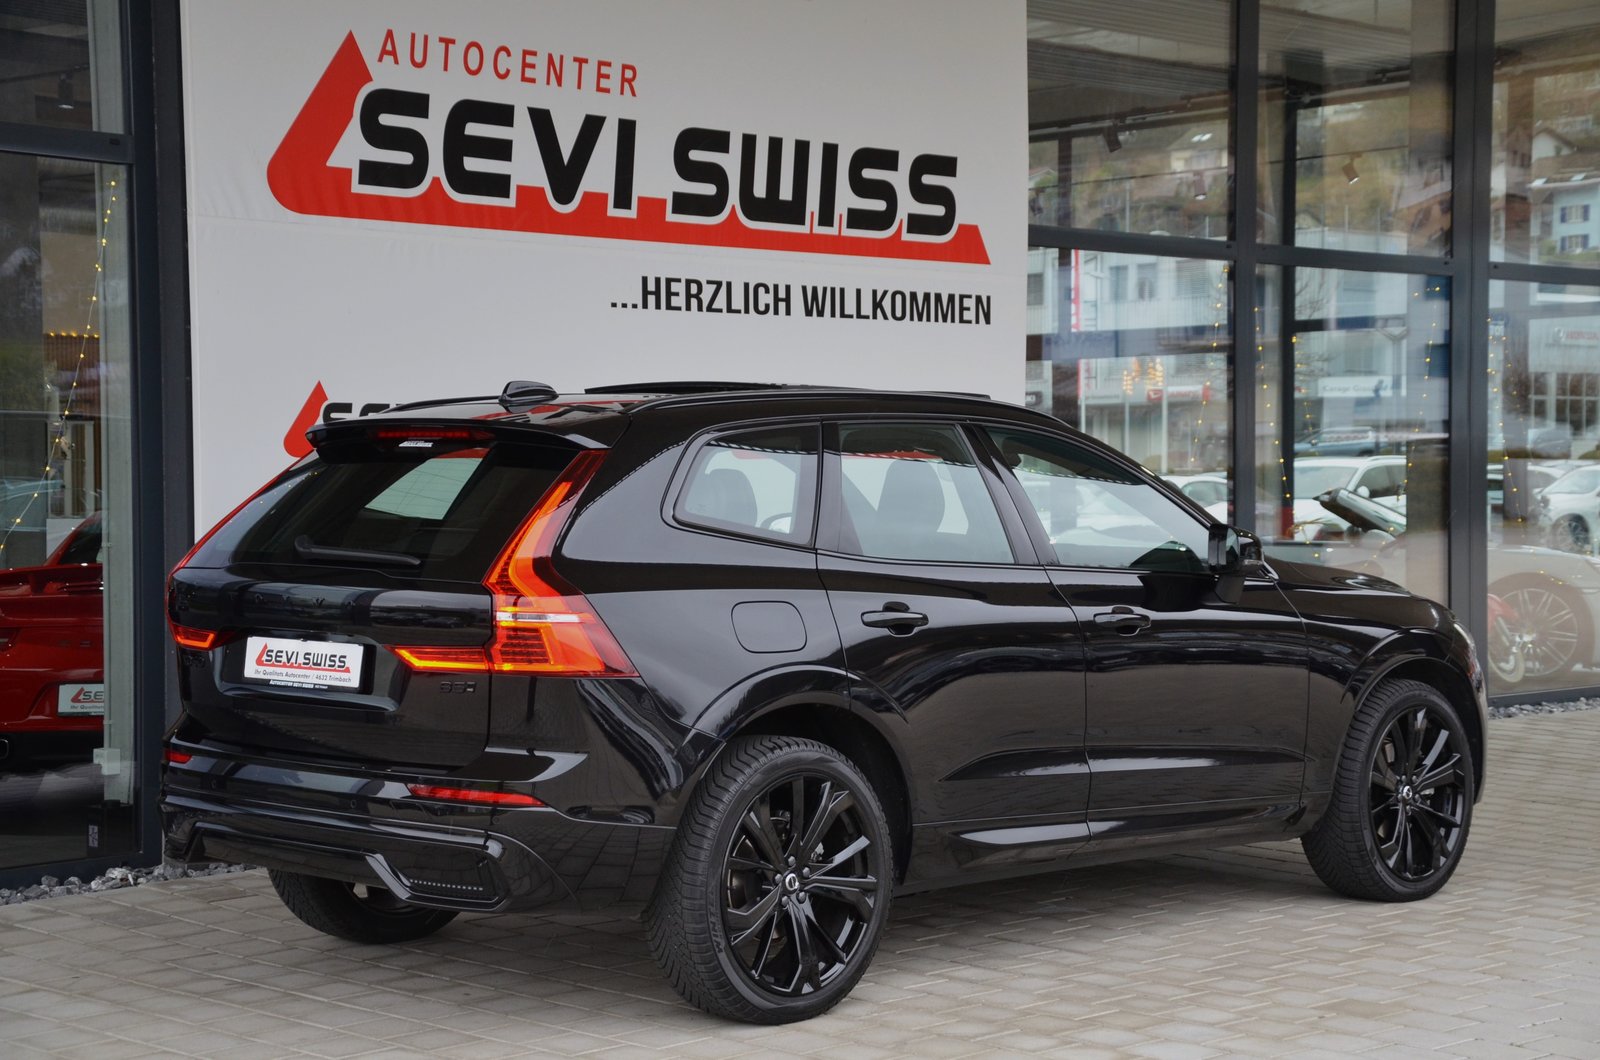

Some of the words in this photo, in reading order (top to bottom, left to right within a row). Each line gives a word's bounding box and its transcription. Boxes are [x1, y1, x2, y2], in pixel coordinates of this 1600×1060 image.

[377, 29, 638, 97] AUTOCENTER
[358, 88, 637, 210] SEVI
[671, 127, 958, 237] SWISS
[801, 285, 992, 325] WILLKOMMEN
[265, 649, 299, 665] SEVI
[302, 652, 347, 669] SWISS
